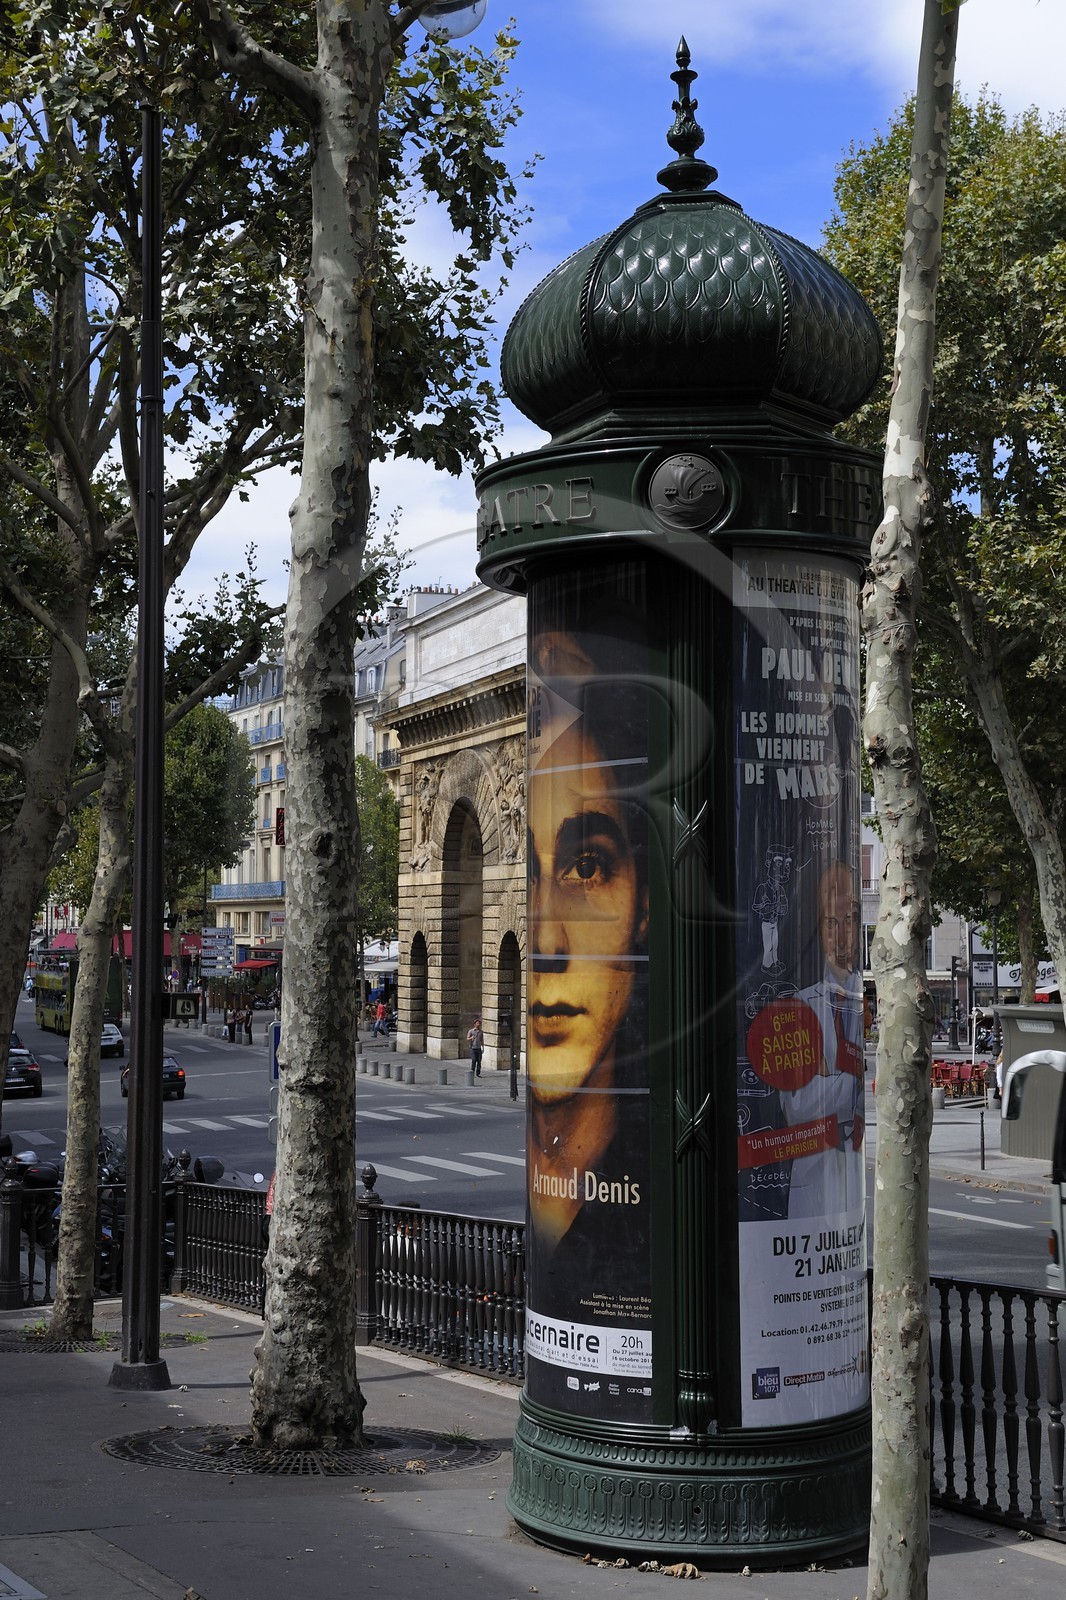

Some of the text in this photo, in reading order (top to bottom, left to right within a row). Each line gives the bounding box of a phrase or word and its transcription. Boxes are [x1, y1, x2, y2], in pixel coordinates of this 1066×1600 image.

[748, 577, 764, 592] AU
[768, 578, 814, 596] THEATRE
[761, 647, 815, 681] PAUL
[741, 711, 830, 737] LES HOMMES
[756, 737, 825, 762] VIENNENT
[744, 763, 840, 801] DE MARS
[181, 1001, 192, 1013] 49
[763, 1028, 810, 1055] SAISON
[762, 1048, 816, 1075] À PARIS!
[765, 1134, 793, 1148] humour
[795, 1123, 825, 1139] imparable
[774, 1140, 818, 1159] LE PARISIEN
[533, 1164, 641, 1205] Arnaud Denis
[773, 1235, 797, 1257] DU
[801, 1235, 811, 1254] 7
[815, 1225, 857, 1253] JUILLET
[794, 1258, 812, 1277] 21
[818, 1247, 861, 1275] JANVIER
[773, 1293, 801, 1304] POINTS
[803, 1291, 812, 1301] DE
[621, 1335, 643, 1349] 20h
[761, 1327, 799, 1339] Location:
[807, 1337, 811, 1345] 0
[757, 1376, 779, 1387] bleu
